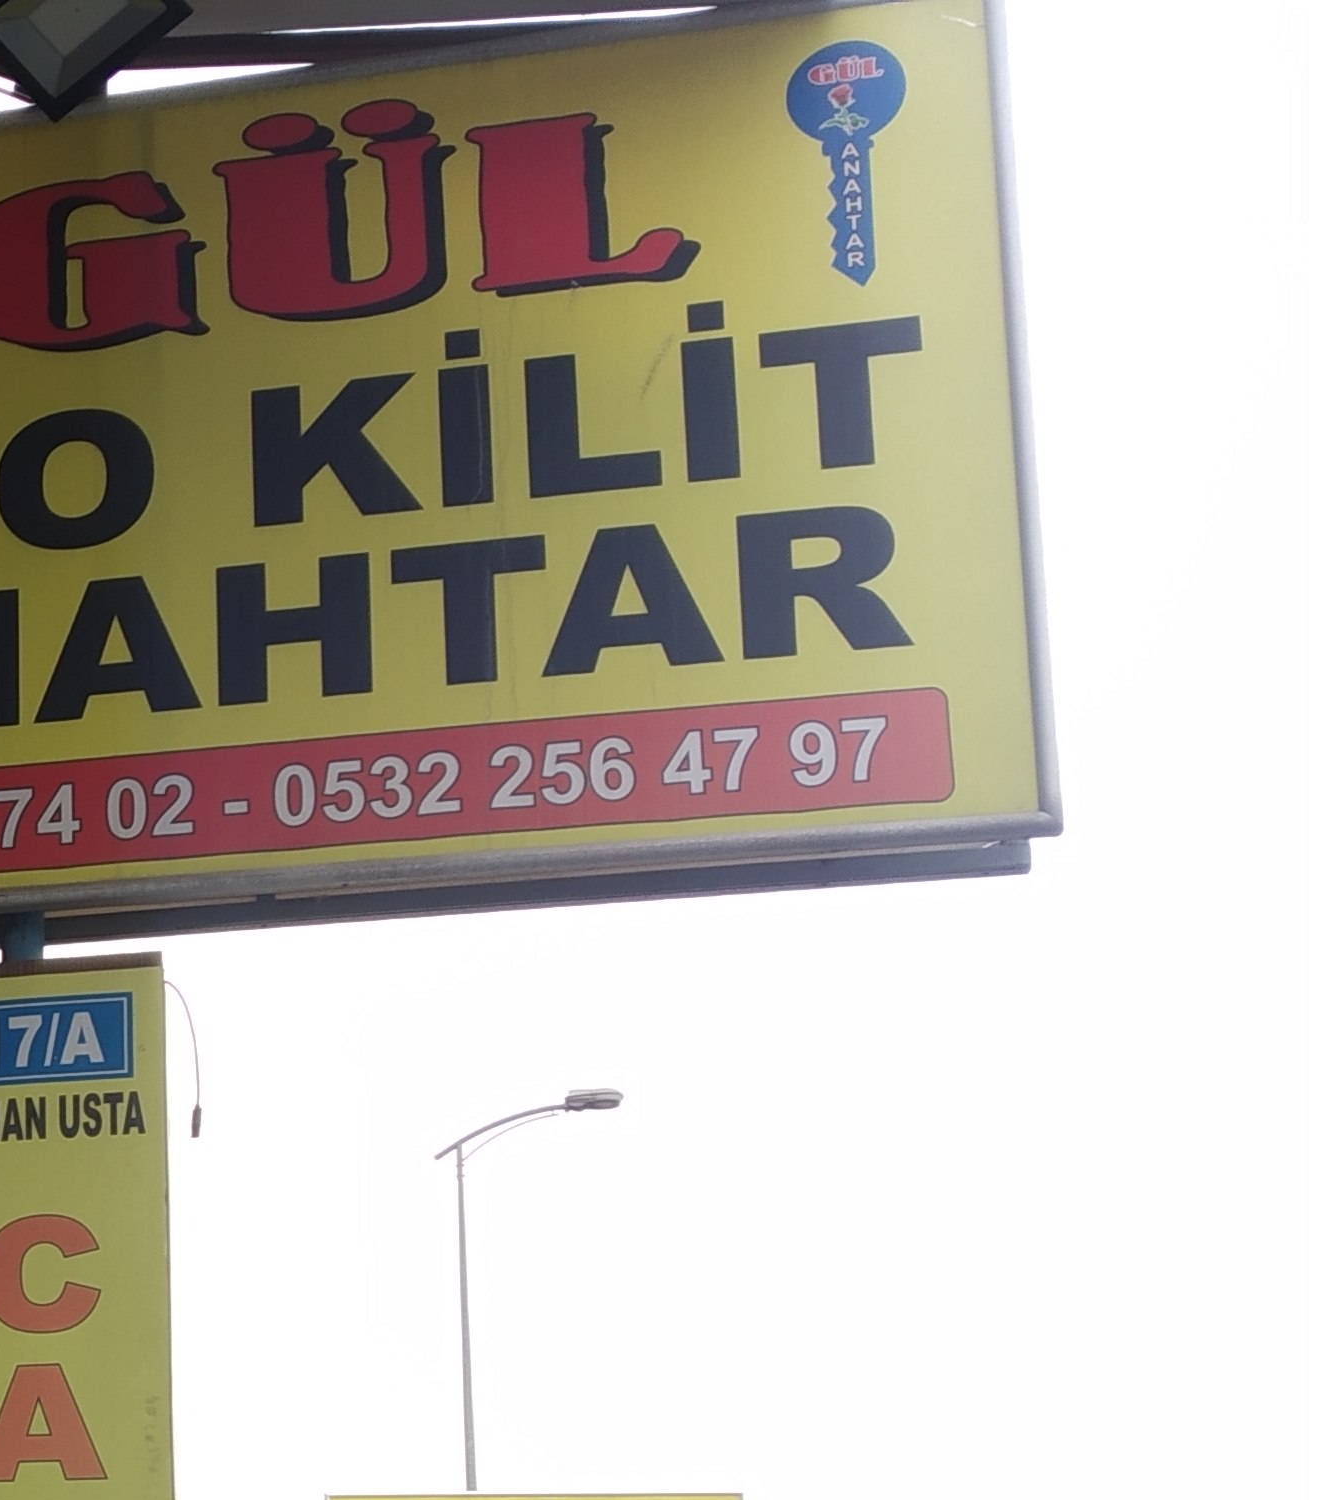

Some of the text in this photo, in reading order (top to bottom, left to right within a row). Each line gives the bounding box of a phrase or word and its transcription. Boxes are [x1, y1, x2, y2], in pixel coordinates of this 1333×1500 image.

[808, 56, 884, 85] GÜL
[841, 143, 865, 268] ANAHTAR
[252, 301, 921, 527] KİLİT
[107, 772, 196, 838] 02
[273, 752, 460, 829] 0532
[490, 735, 635, 811] 256
[662, 723, 755, 796] 47
[790, 715, 887, 786] 97
[59, 1091, 146, 1140] USTA
